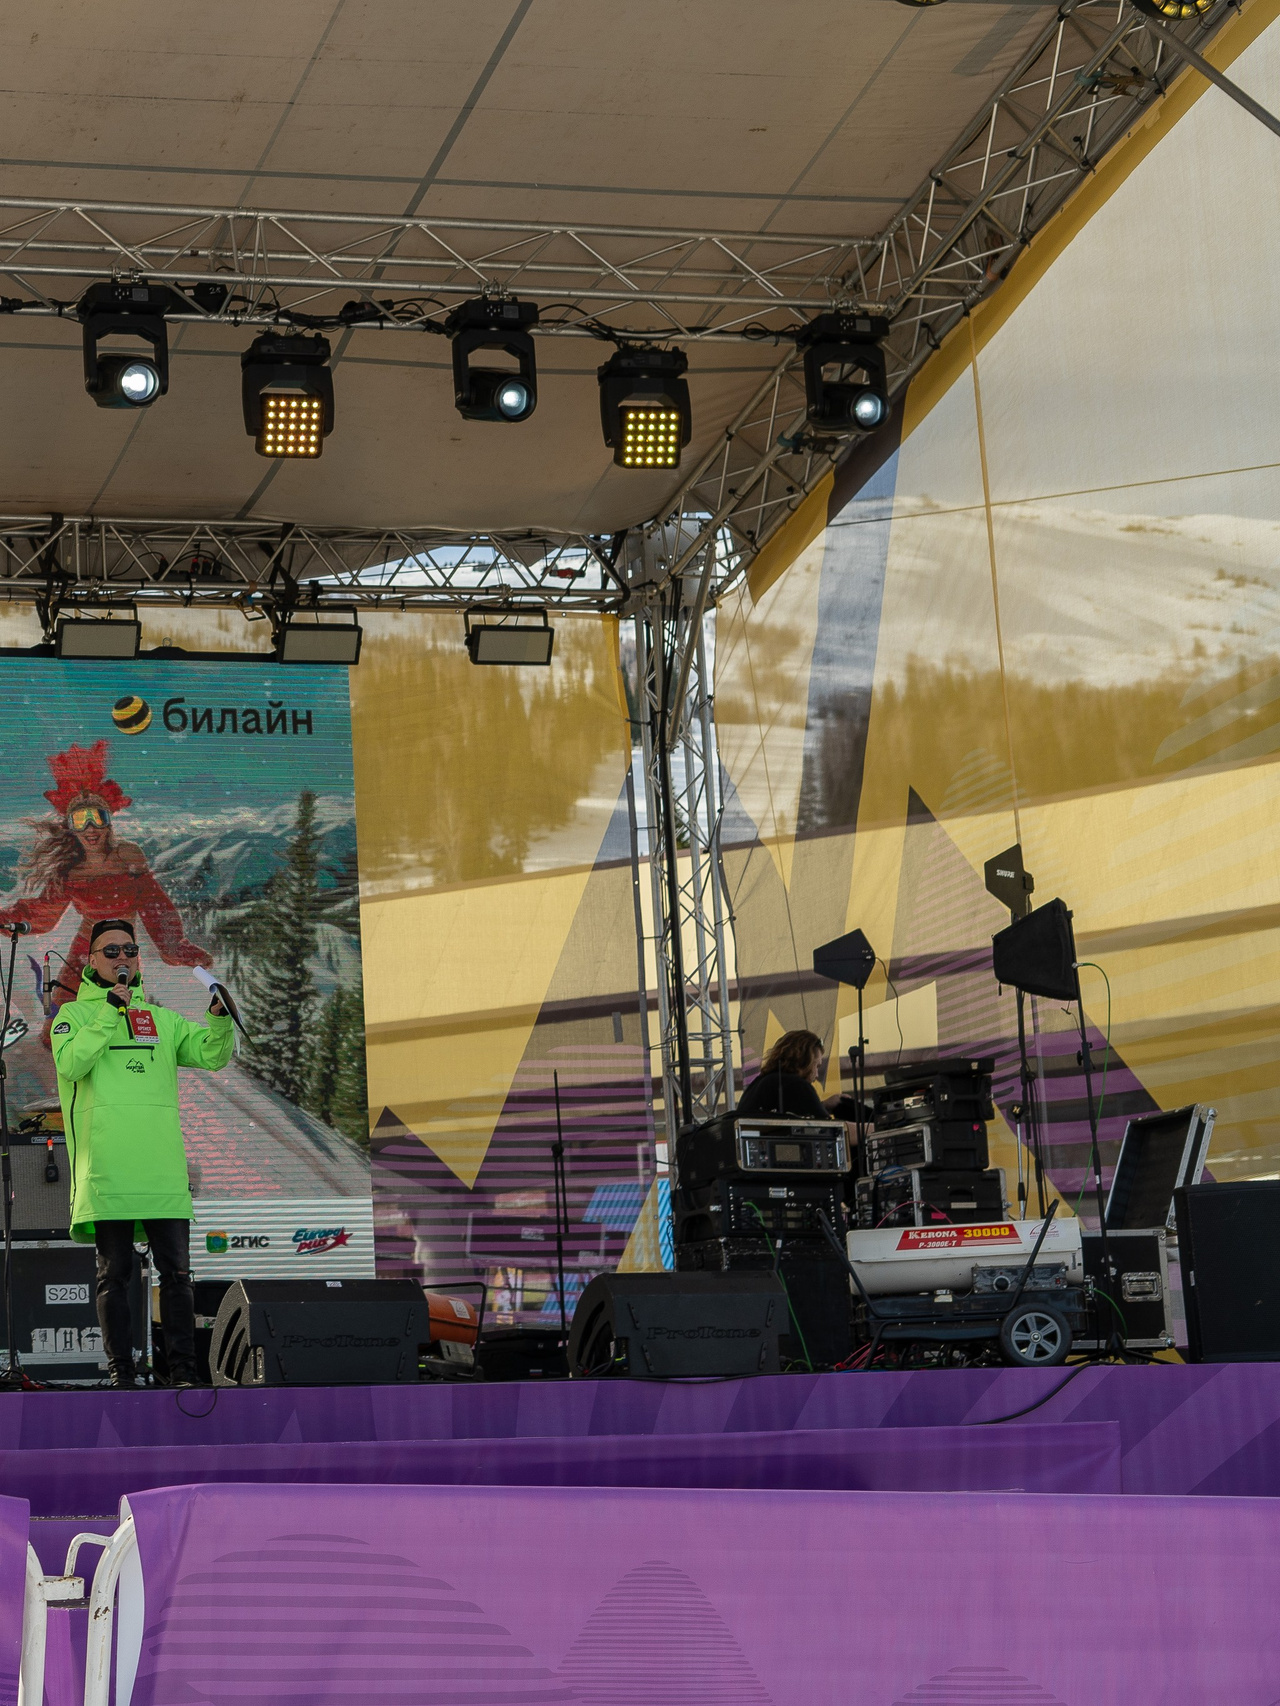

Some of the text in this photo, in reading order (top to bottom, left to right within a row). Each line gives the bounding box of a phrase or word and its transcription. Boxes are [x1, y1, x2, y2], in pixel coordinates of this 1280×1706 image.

[162, 697, 313, 735] билайн
[996, 868, 1016, 879] SHURE
[963, 1226, 1010, 1238] 30000
[230, 1235, 271, 1249] 2ГИС
[48, 1287, 88, 1302] S250
[646, 1325, 763, 1341] ProTone
[280, 1334, 402, 1349] ProTone
